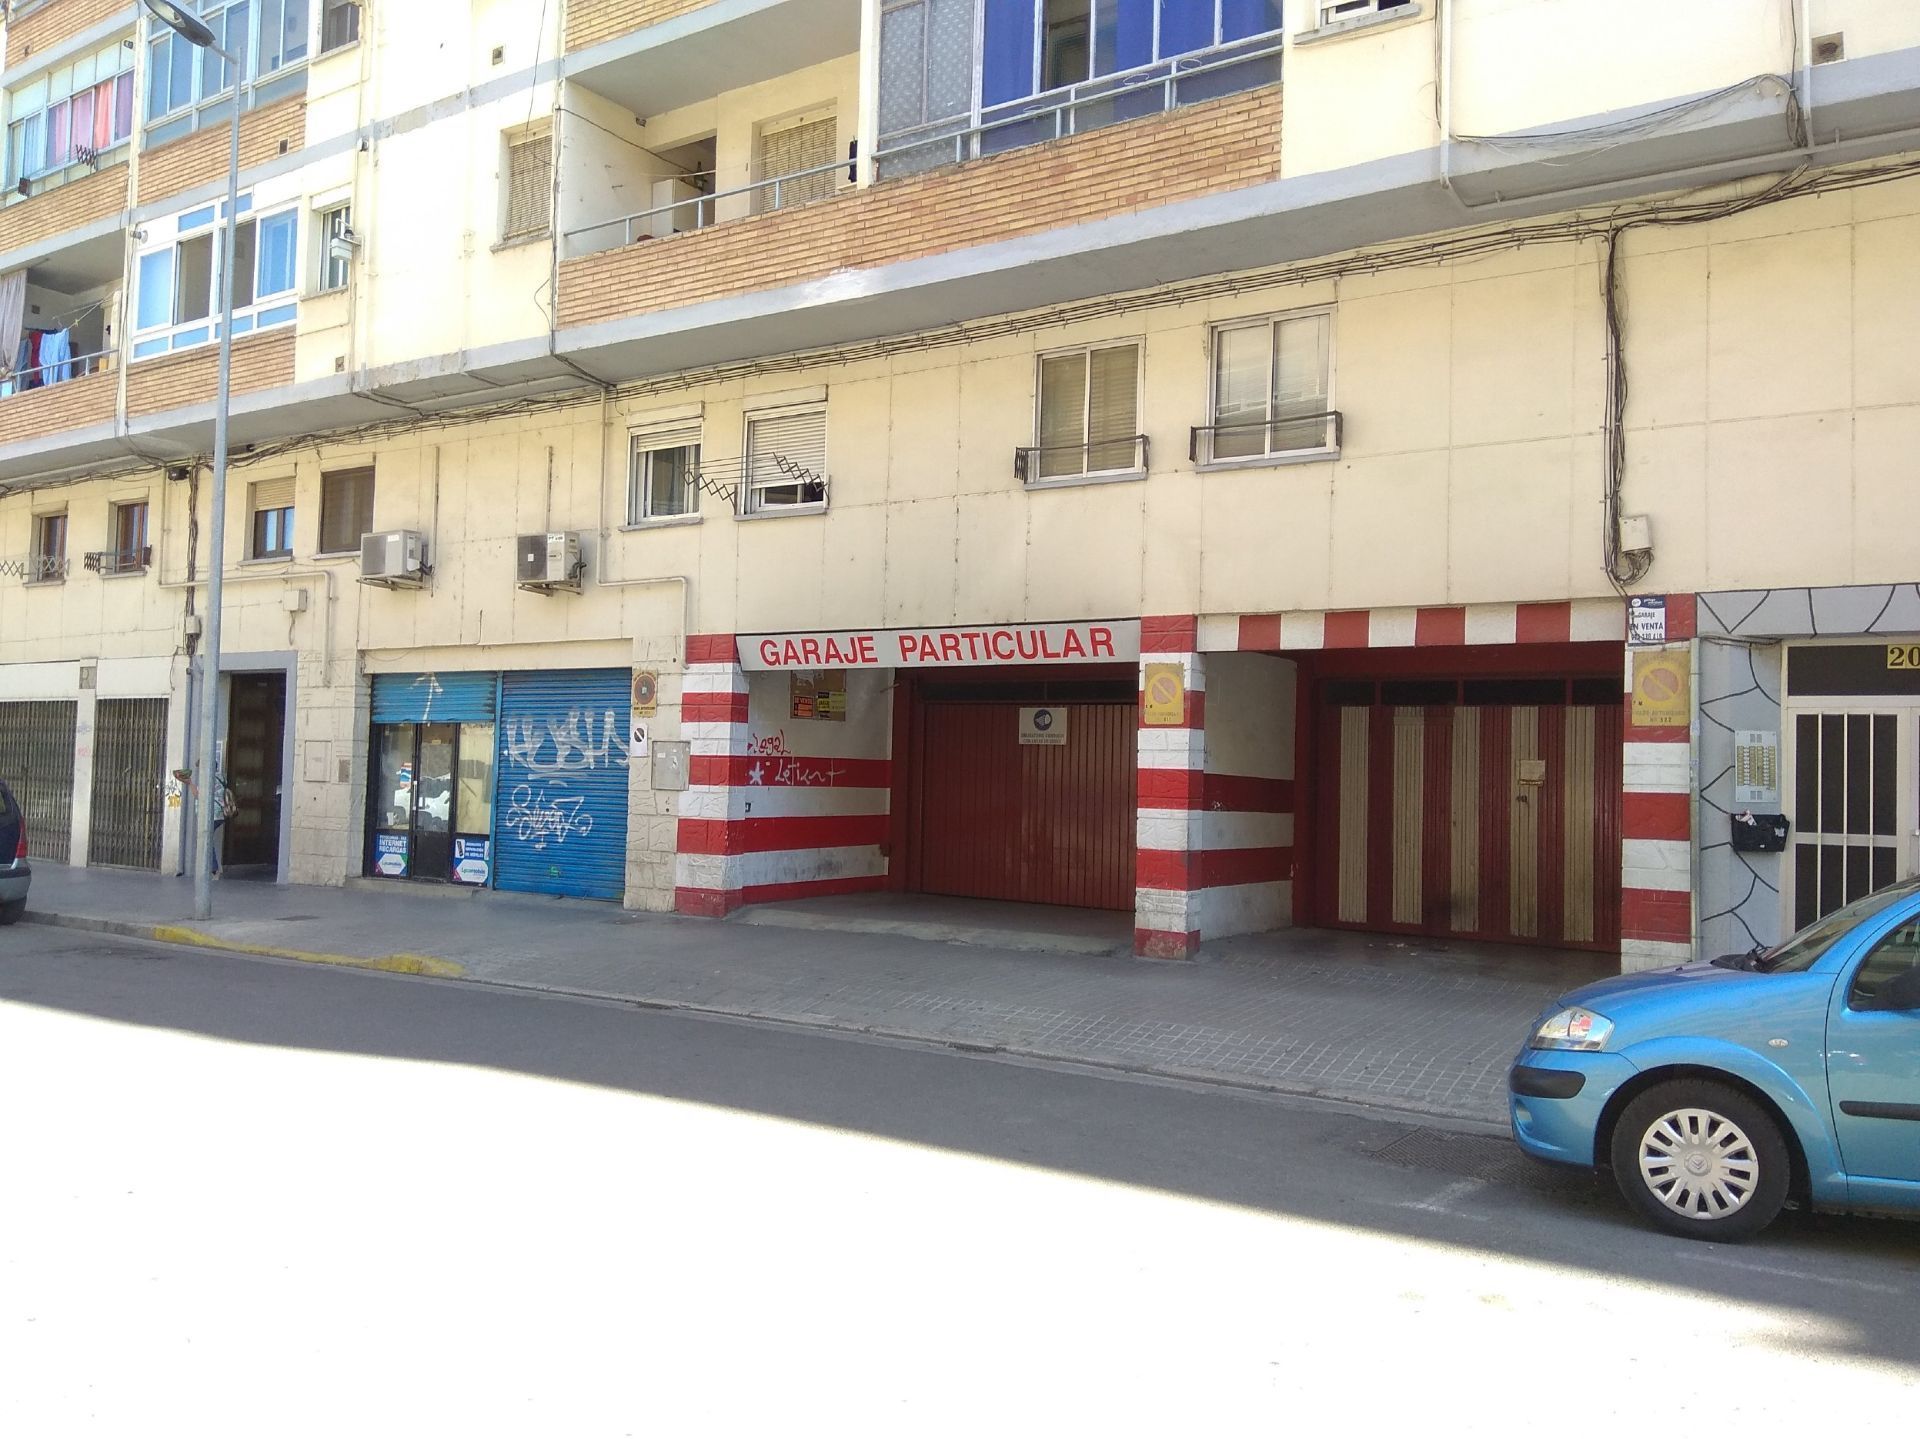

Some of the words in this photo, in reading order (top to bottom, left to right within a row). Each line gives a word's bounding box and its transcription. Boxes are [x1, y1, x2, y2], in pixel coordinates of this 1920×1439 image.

[1641, 622, 1664, 630] VENTA
[759, 635, 879, 667] GARAJE
[898, 626, 1116, 662] PARTICULAR
[1889, 646, 1920, 667] 20
[379, 839, 407, 847] INTERNET
